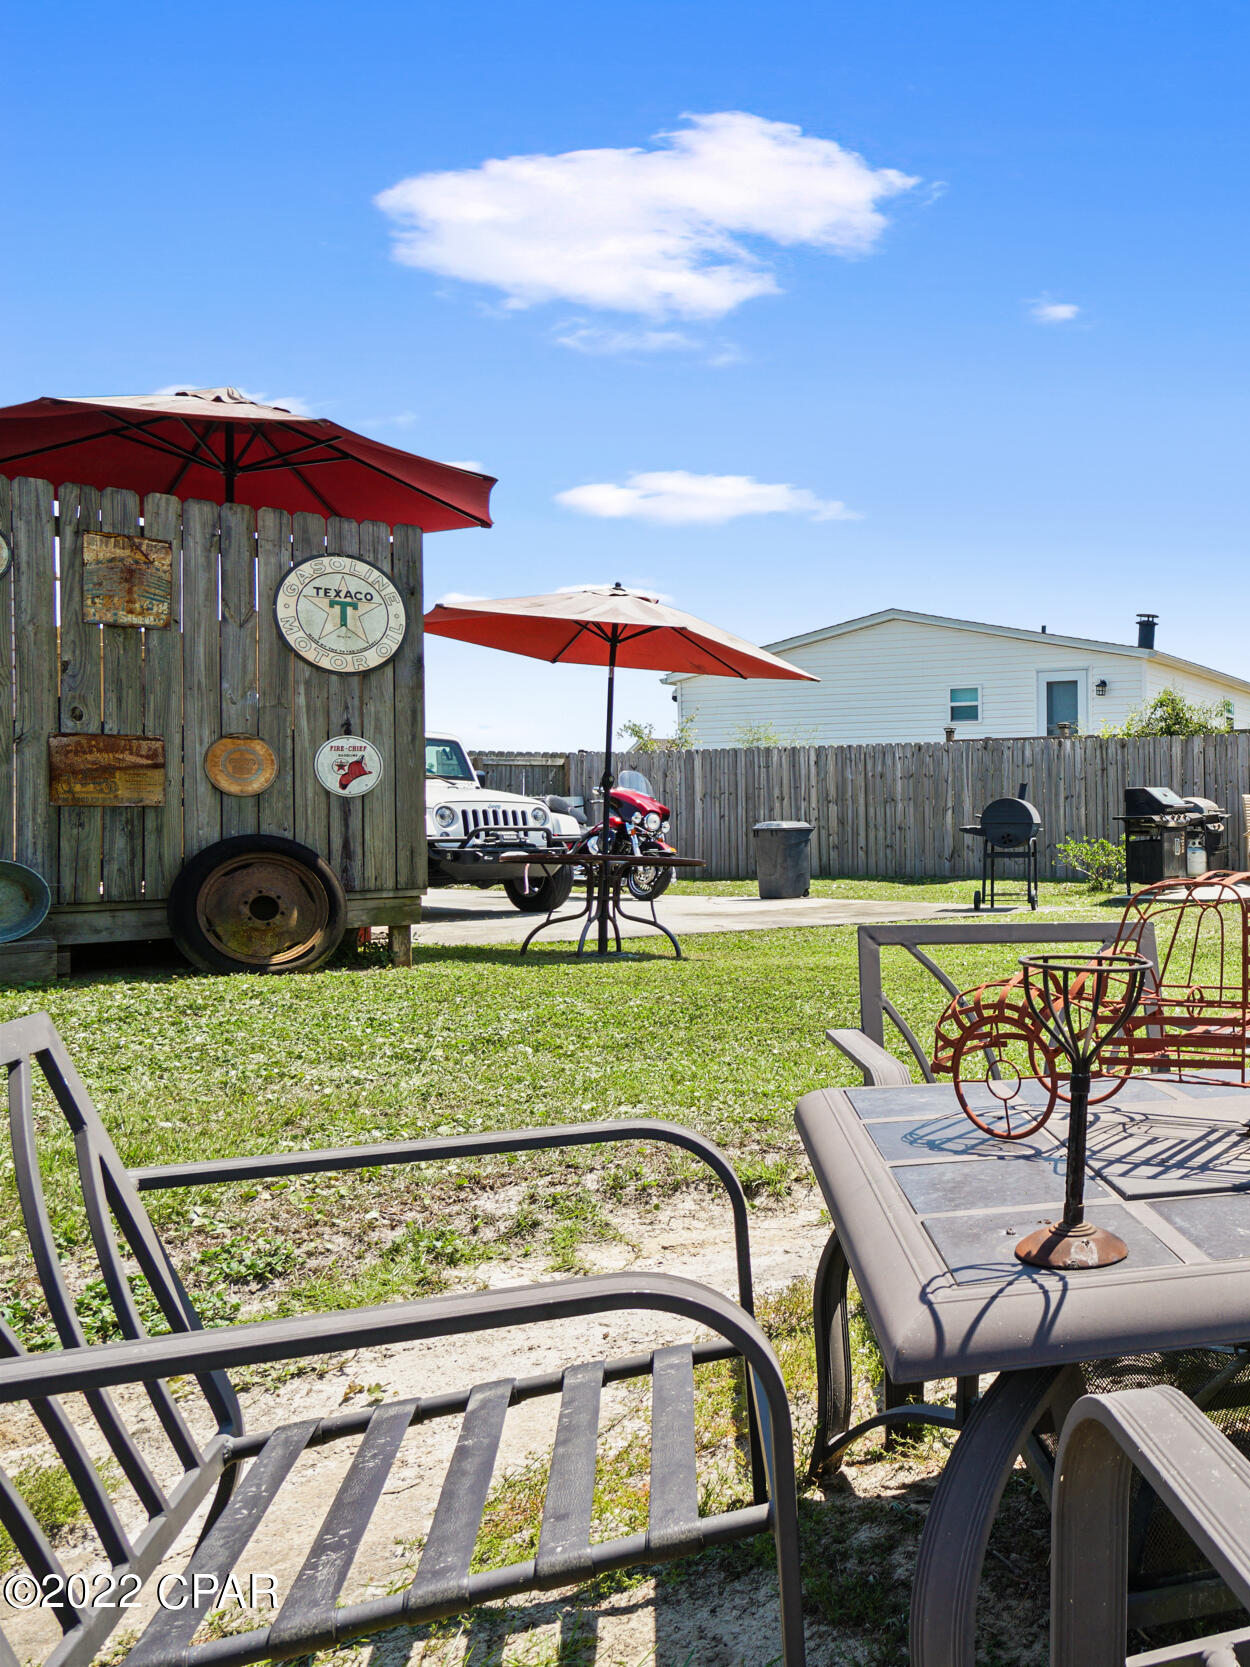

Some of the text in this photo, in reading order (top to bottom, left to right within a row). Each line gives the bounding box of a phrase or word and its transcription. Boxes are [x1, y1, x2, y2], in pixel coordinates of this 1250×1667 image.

[282, 557, 400, 607] GASOLINE
[313, 586, 374, 602] TEXACO
[328, 599, 359, 627] T
[280, 615, 404, 670] MOTOR OIL
